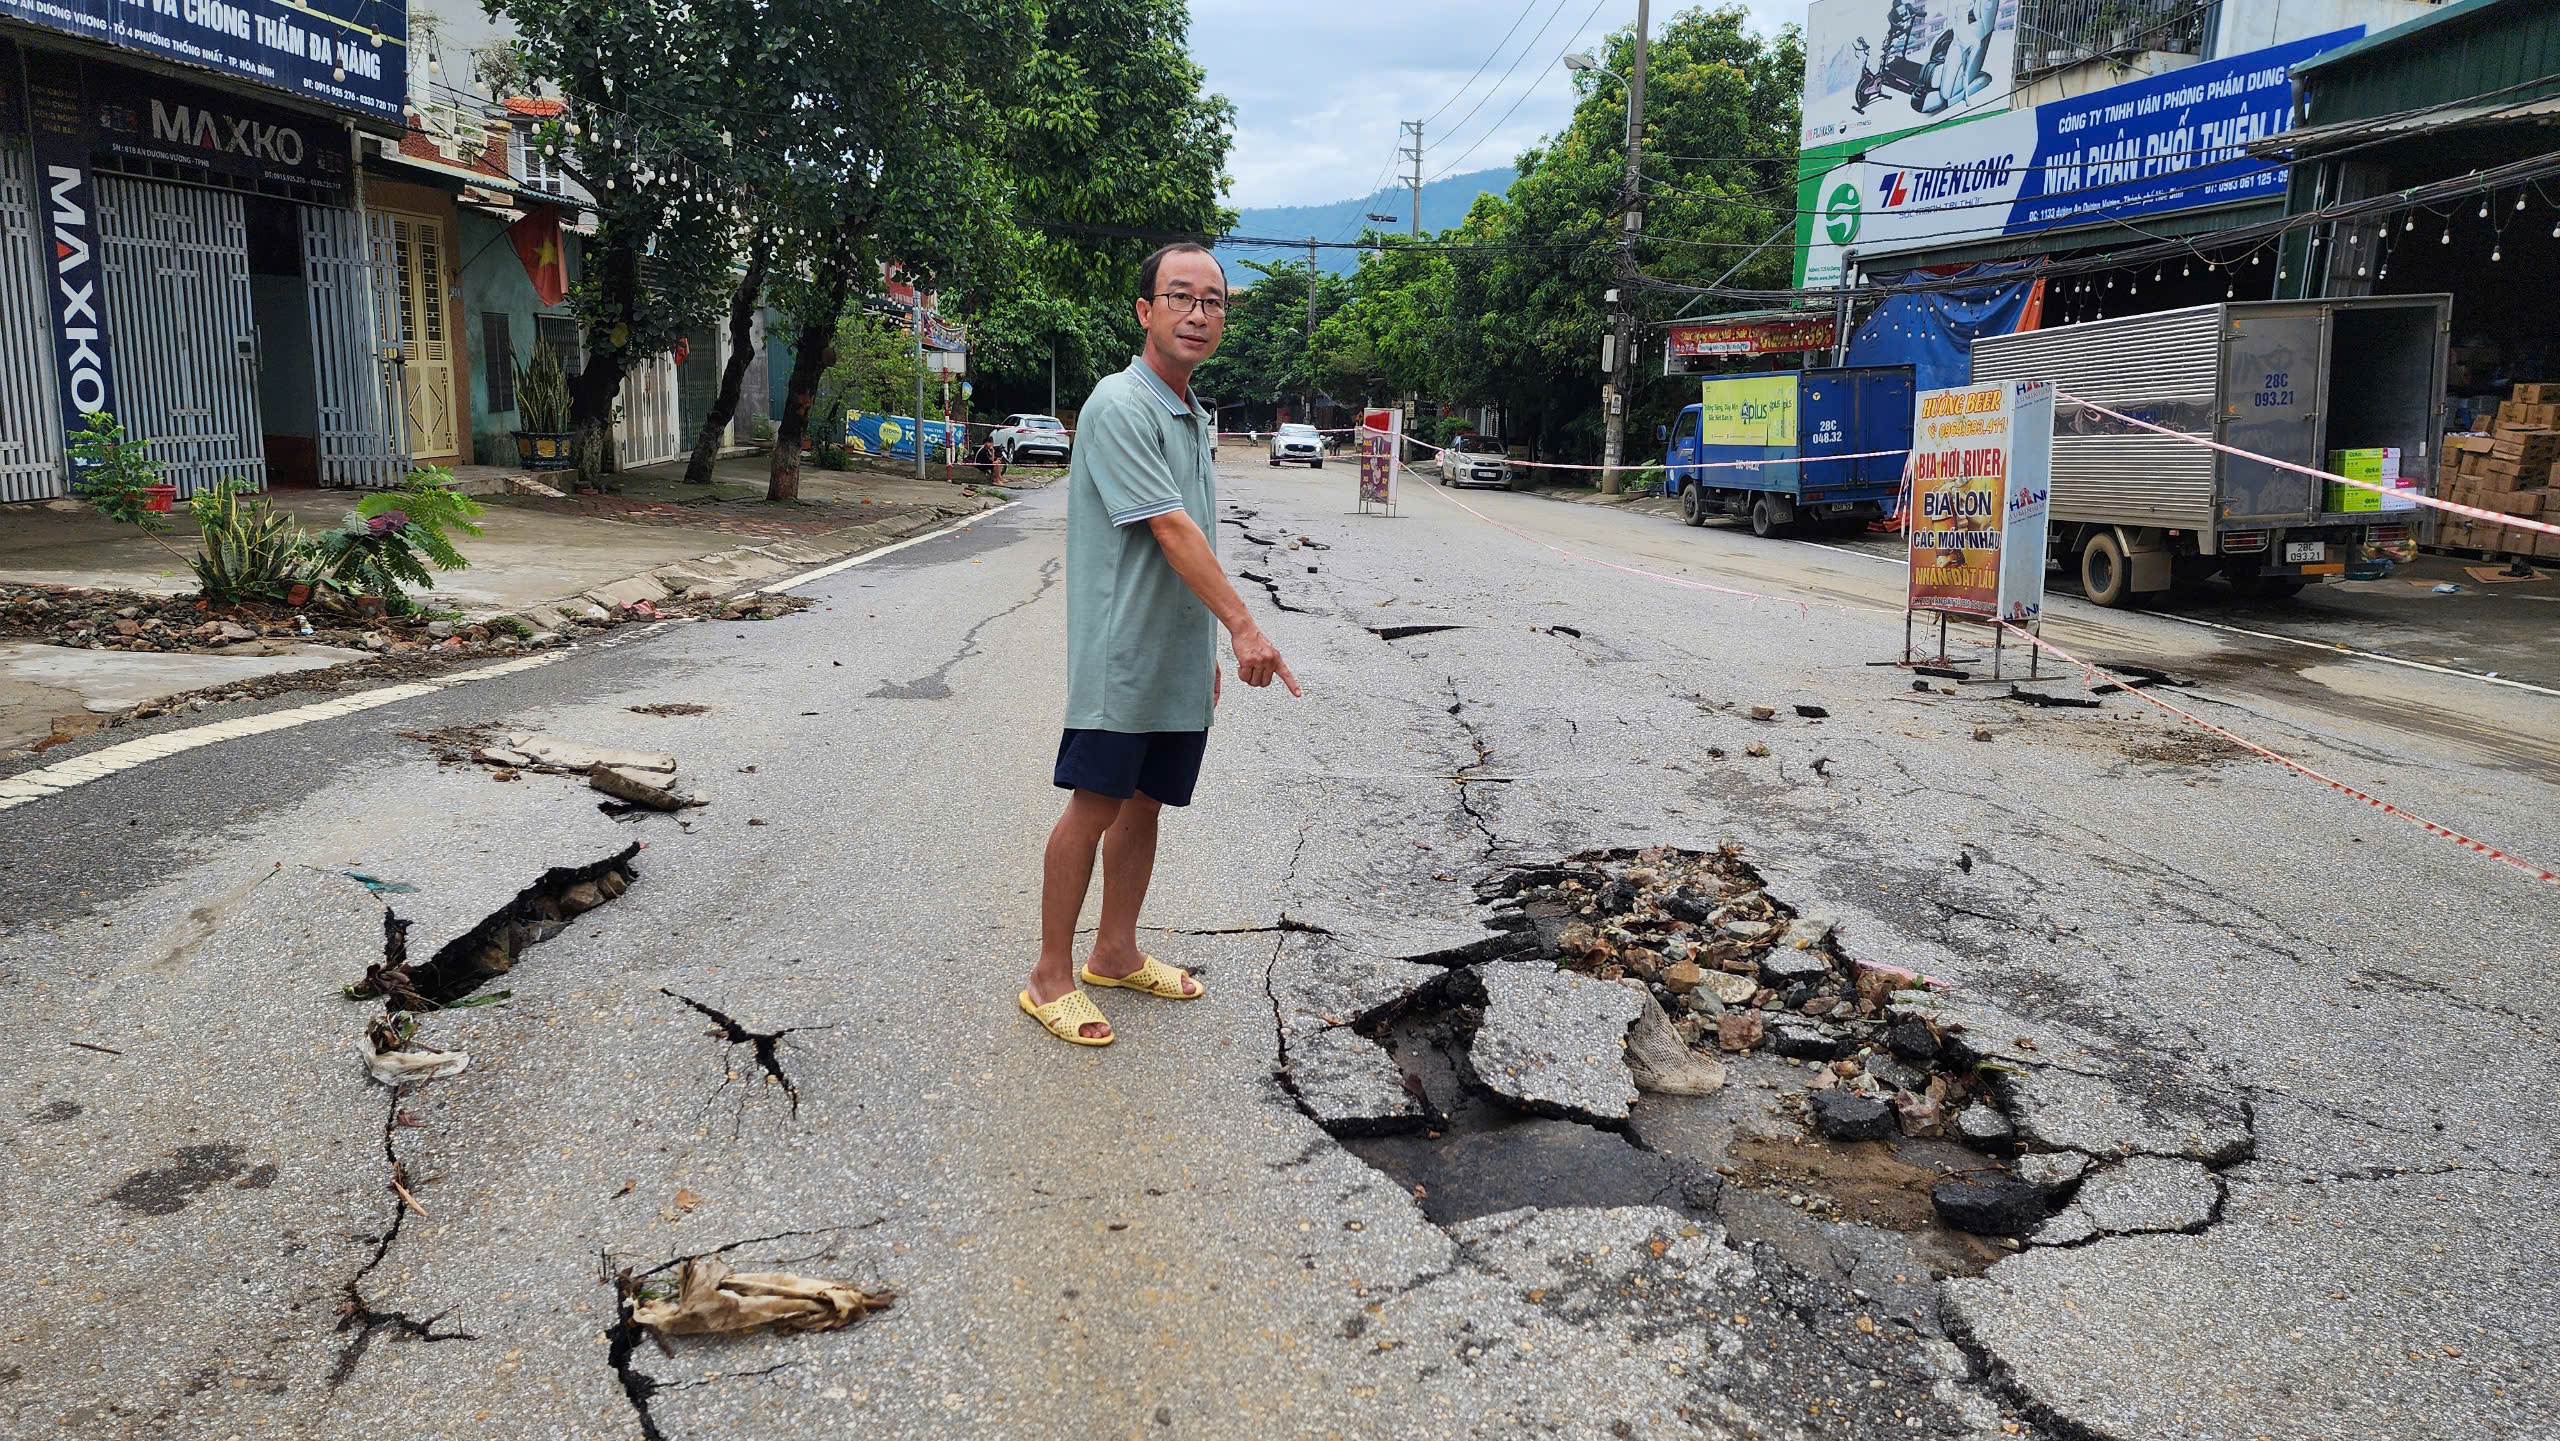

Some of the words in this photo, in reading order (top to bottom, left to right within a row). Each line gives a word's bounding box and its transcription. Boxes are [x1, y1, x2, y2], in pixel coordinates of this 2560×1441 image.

[36, 2, 72, 21] DƯƠNG
[73, 12, 107, 31] VƯƠNG
[113, 20, 125, 35] TỔ
[127, 28, 133, 38] 4
[134, 29, 171, 48] PHƯỜNG
[172, 39, 200, 57] THỐNG
[202, 49, 223, 64] NHẤT
[239, 59, 256, 74] HÒA
[257, 63, 275, 79] BÌNH
[255, 14, 305, 57] THẤM
[309, 32, 333, 66] ĐA
[337, 41, 381, 81] NĂNG
[314, 81, 331, 94] 0915
[331, 86, 343, 98] 925
[343, 89, 356, 101] 276
[375, 99, 387, 110] 720
[387, 103, 398, 113] 717
[2058, 112, 2086, 134] CÔNG
[2089, 109, 2102, 127] TY
[2105, 101, 2134, 123] TNHH
[2137, 94, 2160, 116] VĂN
[2163, 85, 2204, 110] PHÒNG
[2207, 70, 2244, 100] PHẨM
[2247, 65, 2285, 91] DUNG
[151, 98, 304, 165] MAXKO
[2043, 138, 2081, 195] NHÀ
[2086, 128, 2140, 187] PHÂN
[2144, 107, 2194, 177] PHỐI
[2201, 101, 2267, 165] THIÊN
[2239, 177, 2255, 189] 061
[2257, 173, 2271, 186] 125
[2041, 208, 2055, 219] 1133
[48, 165, 105, 414] MAXKO
[2265, 373, 2288, 388] 28C
[1966, 390, 2002, 413] BEER
[2255, 391, 2294, 406] 093.21
[1812, 431, 1843, 444] 048.32
[1820, 420, 1837, 432] 28C
[1919, 453, 1937, 480] BIA
[1941, 448, 1960, 478] HƠI
[1963, 448, 2001, 477] RIVER
[1924, 491, 1952, 516] BIA
[1956, 491, 1992, 516] LON
[1913, 528, 1935, 548] CÁC
[1939, 527, 1965, 549] MÓN
[1968, 528, 2000, 554] NHẬU
[2297, 543, 2314, 551] 28C
[2291, 552, 2320, 560] 093.21
[1916, 563, 1948, 589] NHẬN
[1951, 565, 1976, 590] ĐẶT
